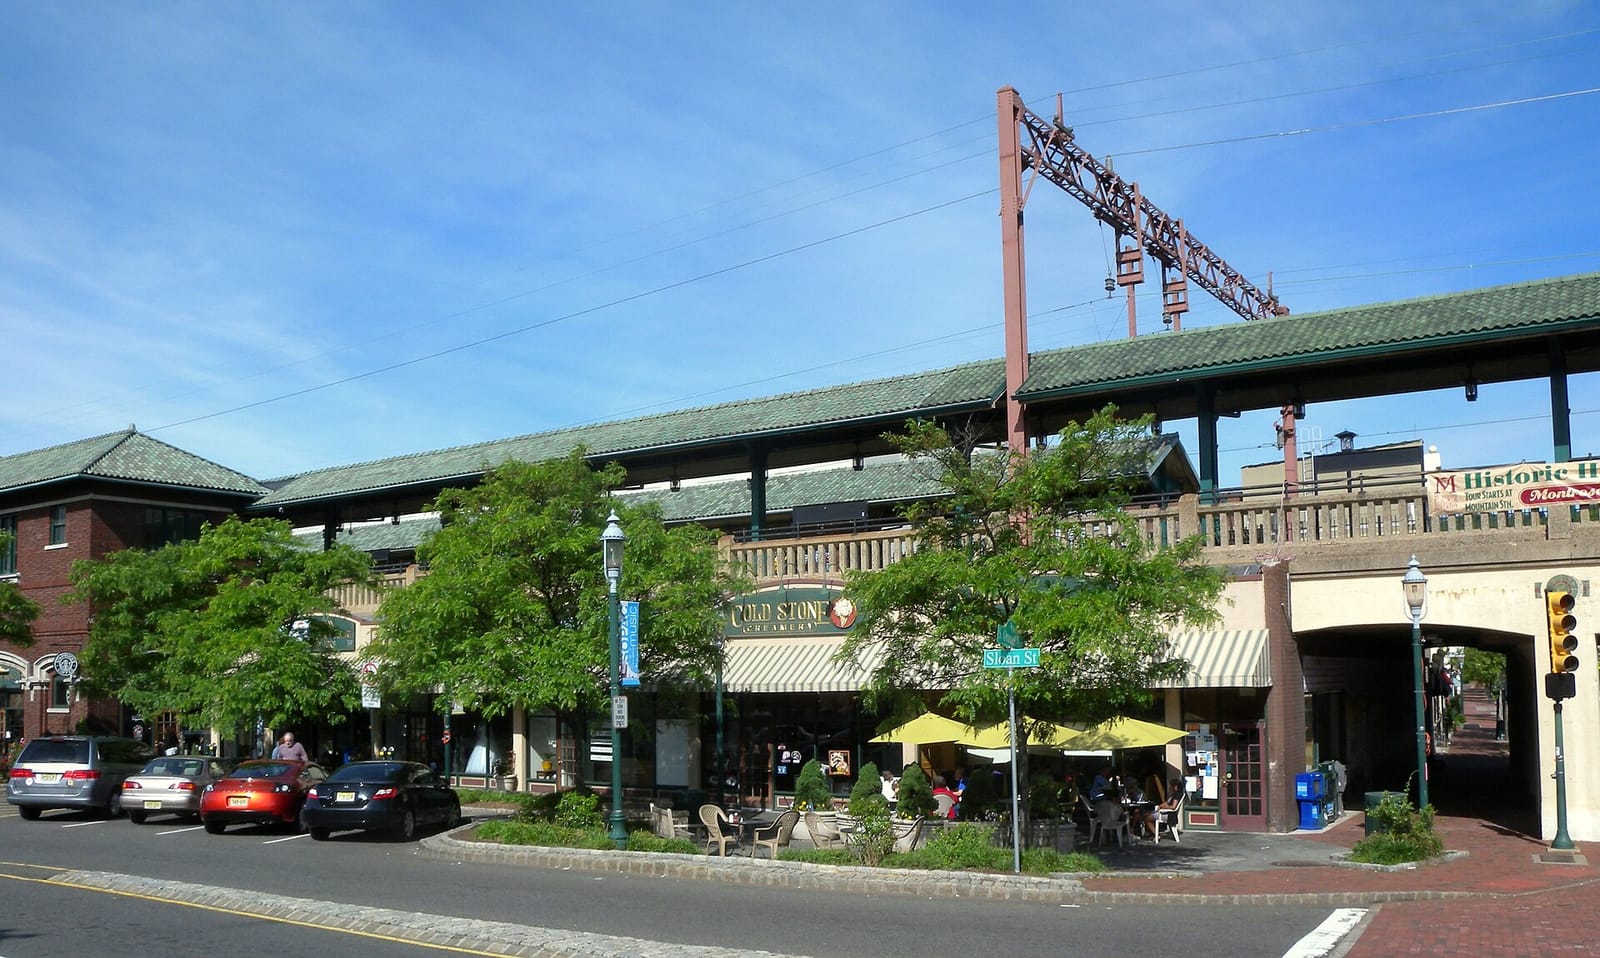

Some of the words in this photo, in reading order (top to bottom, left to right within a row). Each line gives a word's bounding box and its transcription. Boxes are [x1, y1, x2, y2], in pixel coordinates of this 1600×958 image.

[1464, 465, 1568, 490] Historic
[1465, 492, 1481, 501] TOUR
[1482, 490, 1504, 500] STARTS
[1504, 489, 1513, 498] AT
[1465, 501, 1499, 511] MOUNTAIN
[731, 603, 771, 628] COLD
[776, 600, 830, 625] STONE
[629, 605, 638, 647] music
[742, 622, 818, 633] CREAMERY
[986, 651, 1020, 665] Sloan
[1024, 651, 1037, 664] St
